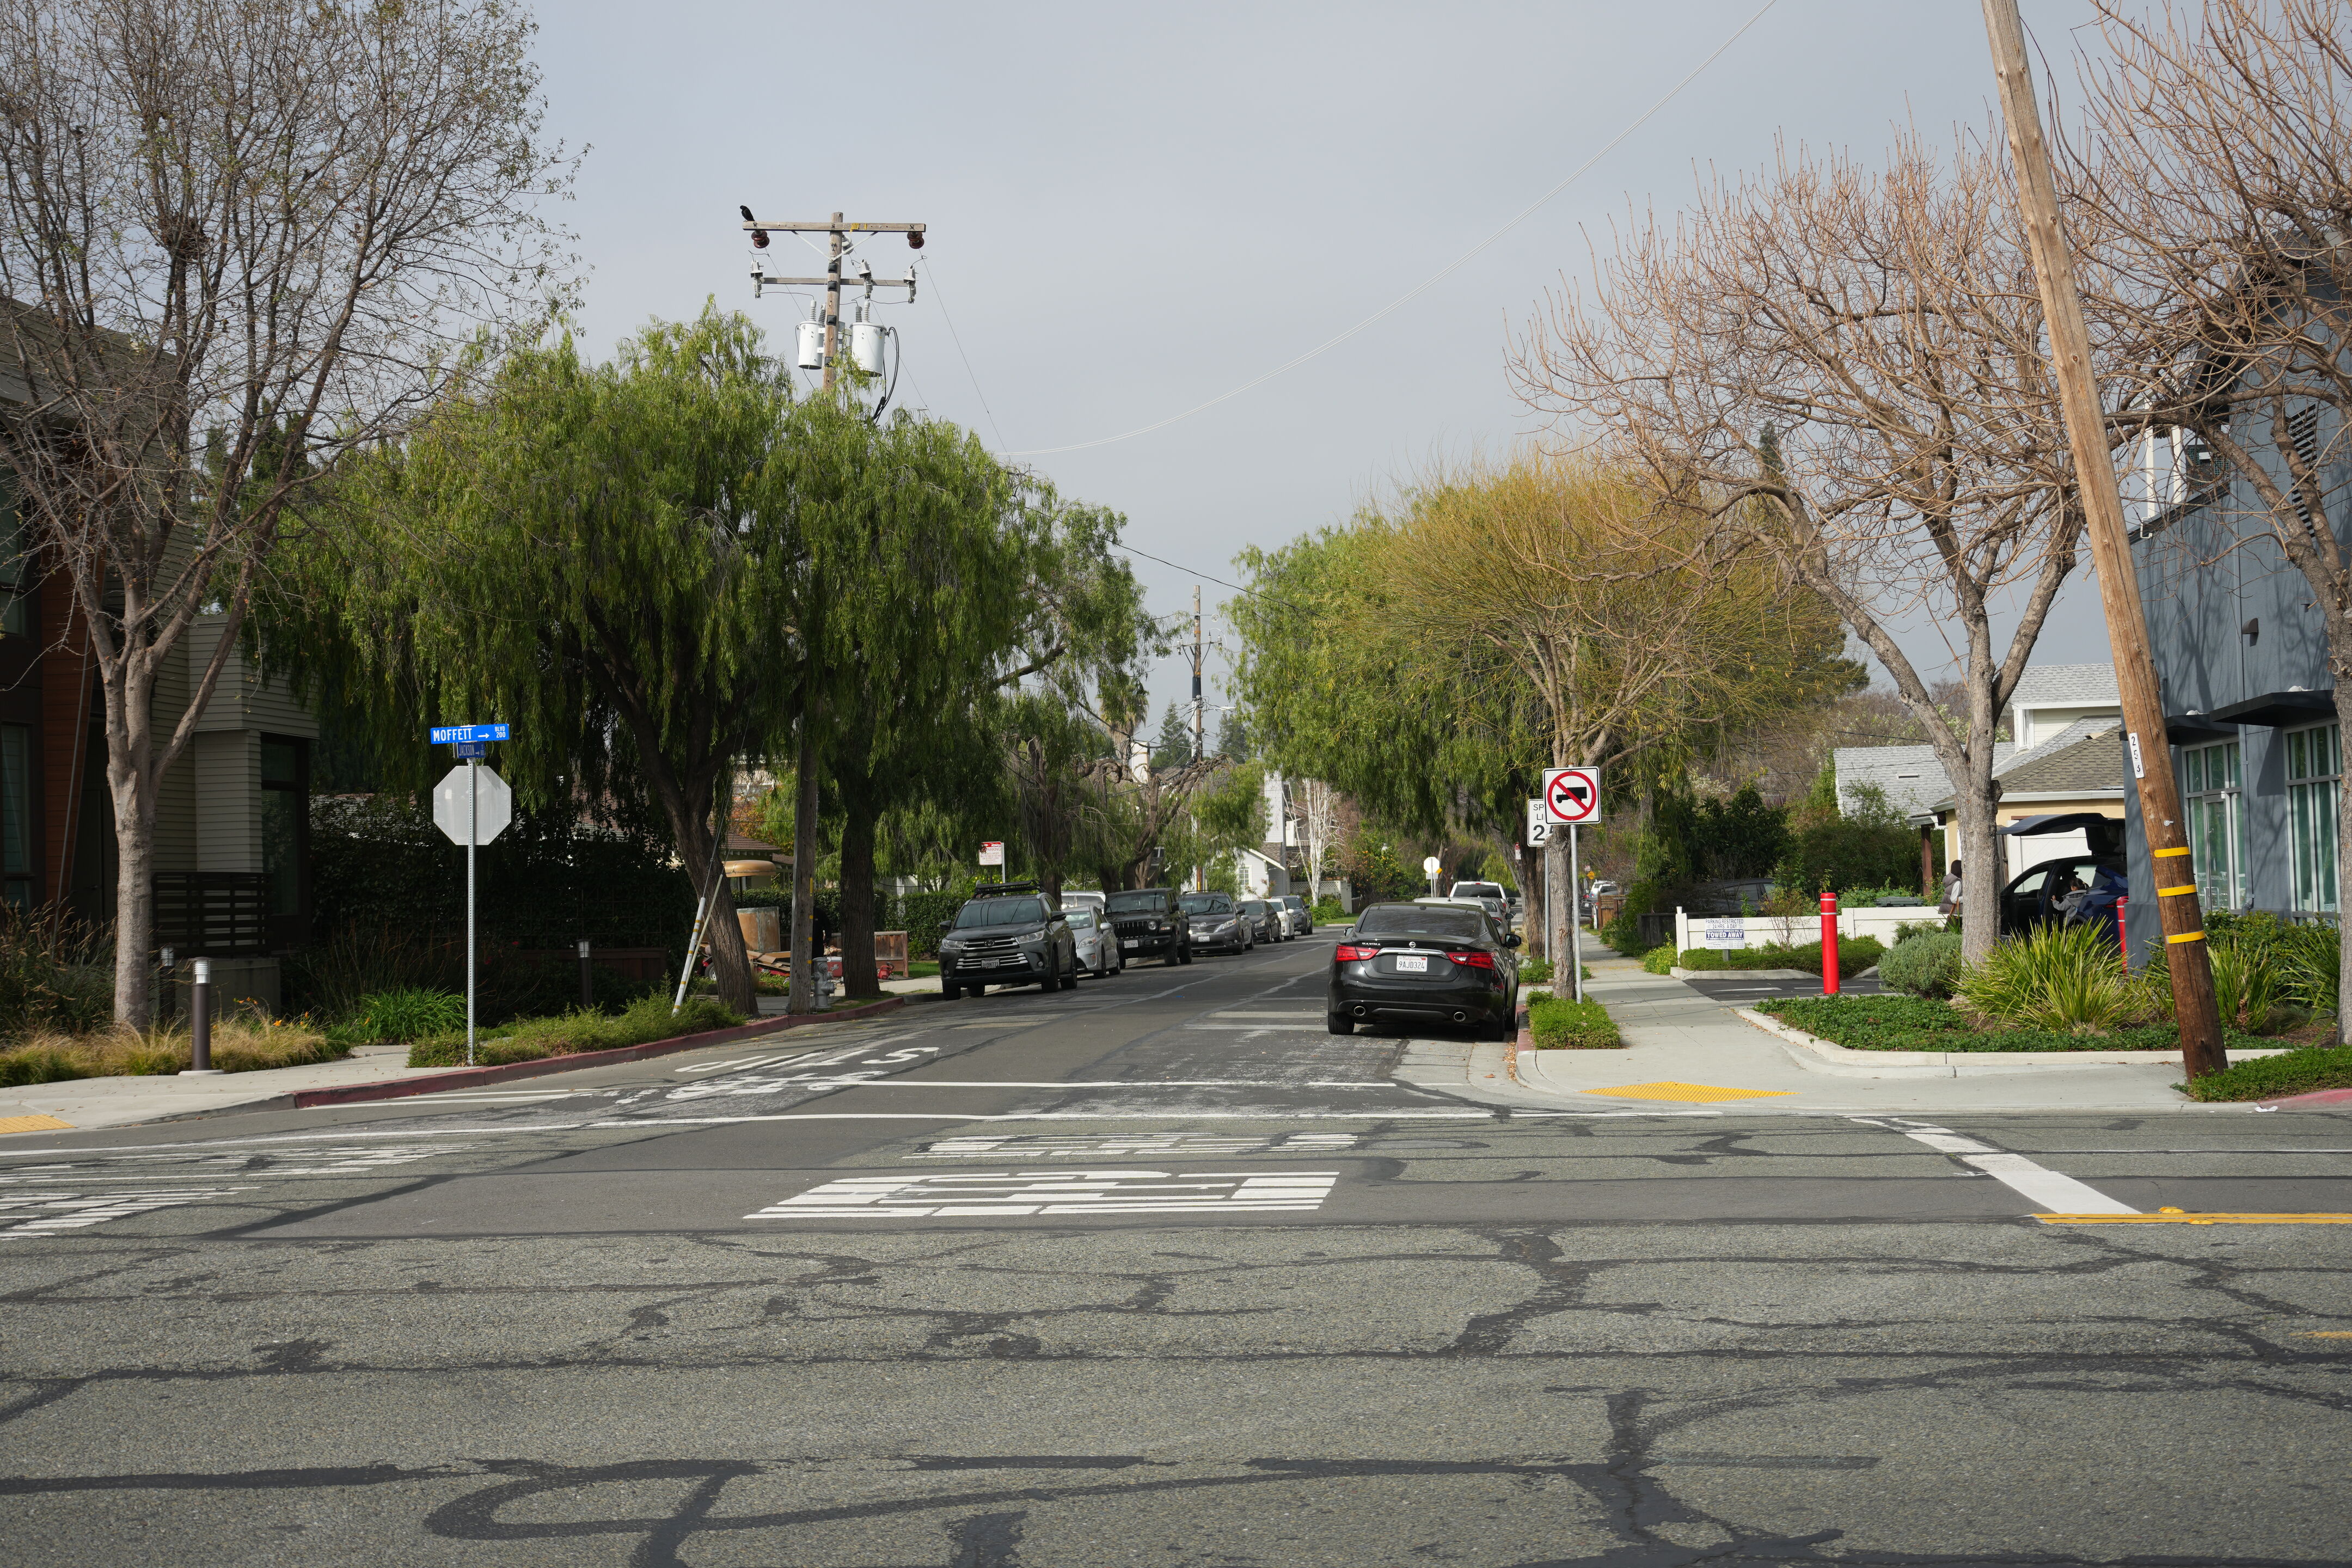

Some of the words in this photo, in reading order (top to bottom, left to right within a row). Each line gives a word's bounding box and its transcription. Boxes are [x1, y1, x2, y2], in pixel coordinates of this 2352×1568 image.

[433, 728, 472, 742] MOFFETT
[459, 744, 475, 756] JACKSON
[1399, 961, 1425, 969] 9AJD324
[675, 1047, 940, 1072] STOP
